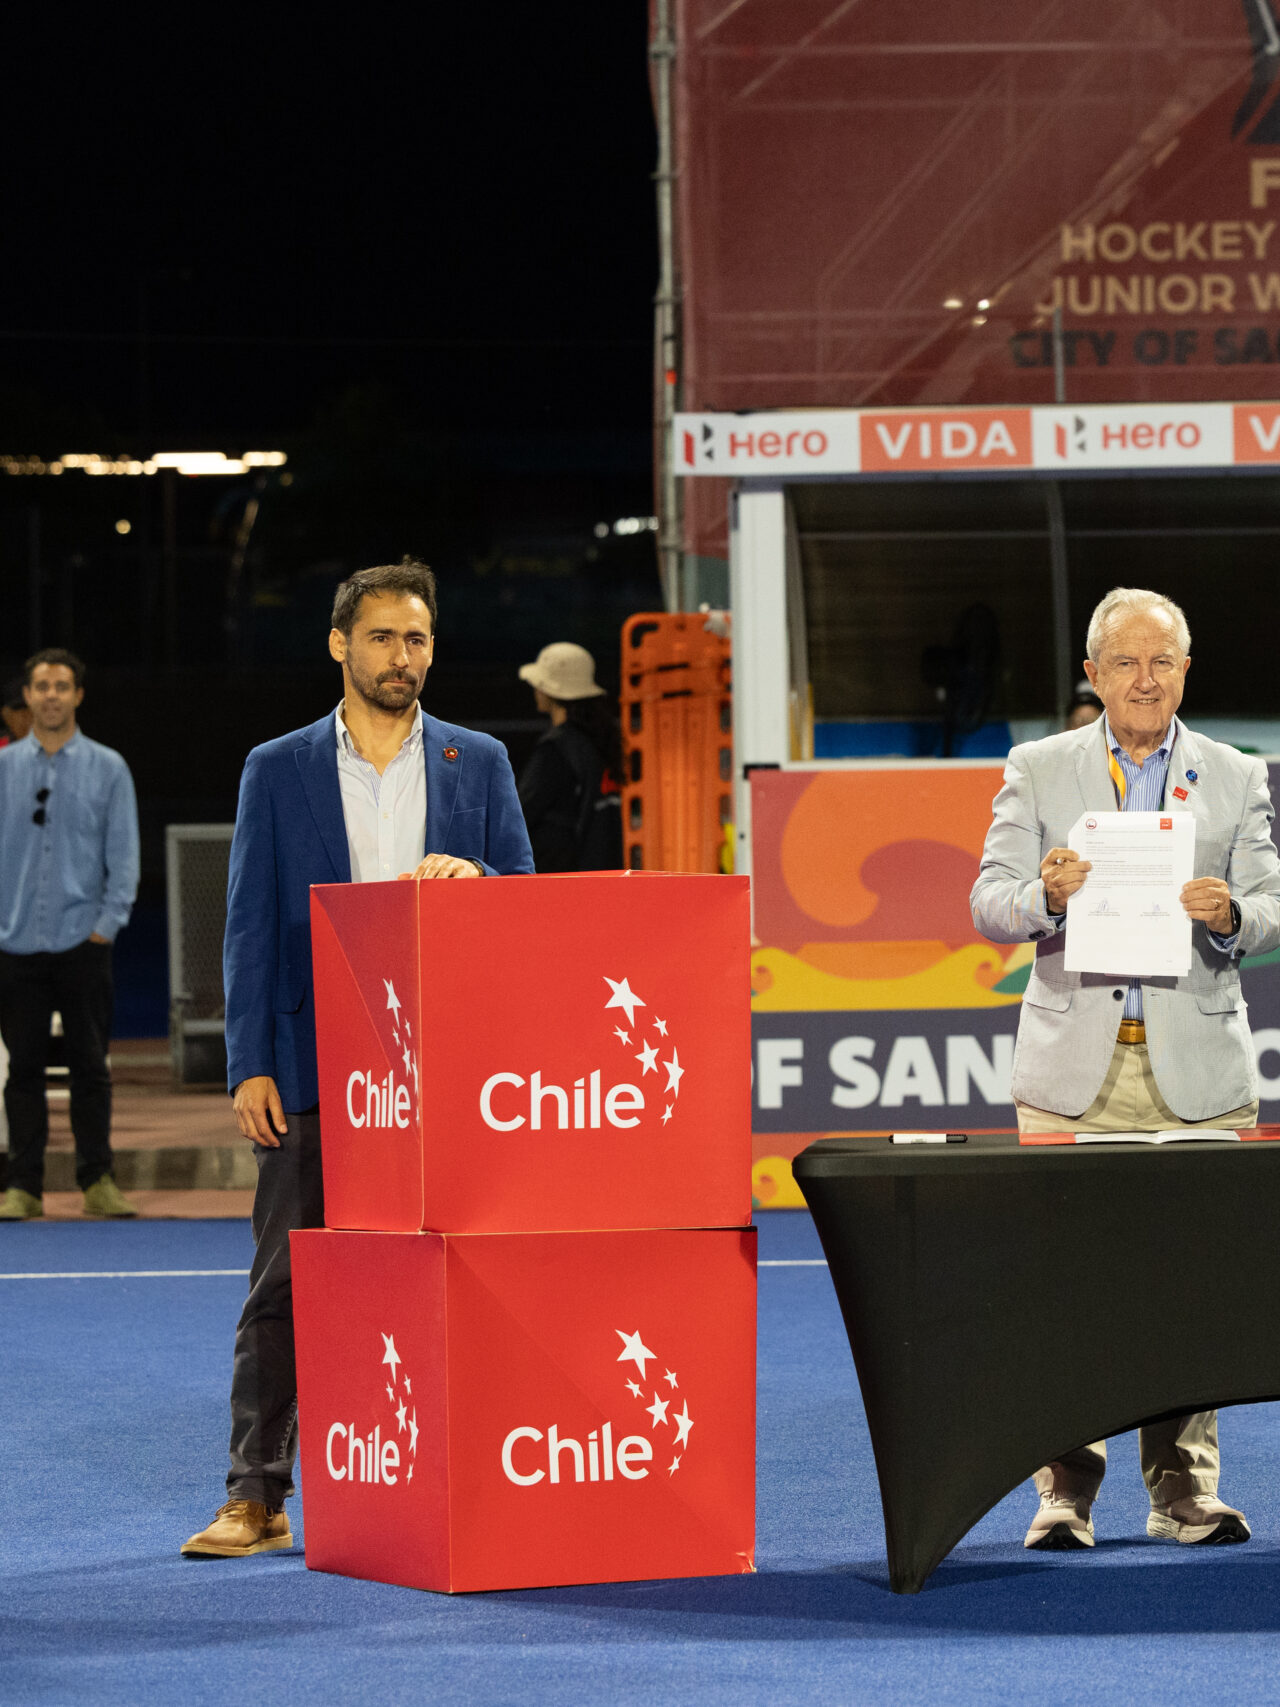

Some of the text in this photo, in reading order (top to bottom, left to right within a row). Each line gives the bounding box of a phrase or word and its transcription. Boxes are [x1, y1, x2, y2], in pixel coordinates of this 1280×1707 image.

[1060, 220, 1276, 263] HOCKEY
[1034, 273, 1237, 316] JUNIOR
[1010, 328, 1117, 368] CITY
[1133, 327, 1199, 366] OF
[729, 430, 829, 459] Hero
[875, 420, 1018, 460] VIDA
[1101, 421, 1202, 450] Hero
[751, 1038, 804, 1110] F
[346, 1070, 411, 1129] Chile
[479, 1069, 645, 1132] Chile
[326, 1422, 400, 1486] Chile
[501, 1421, 653, 1486] Chile
